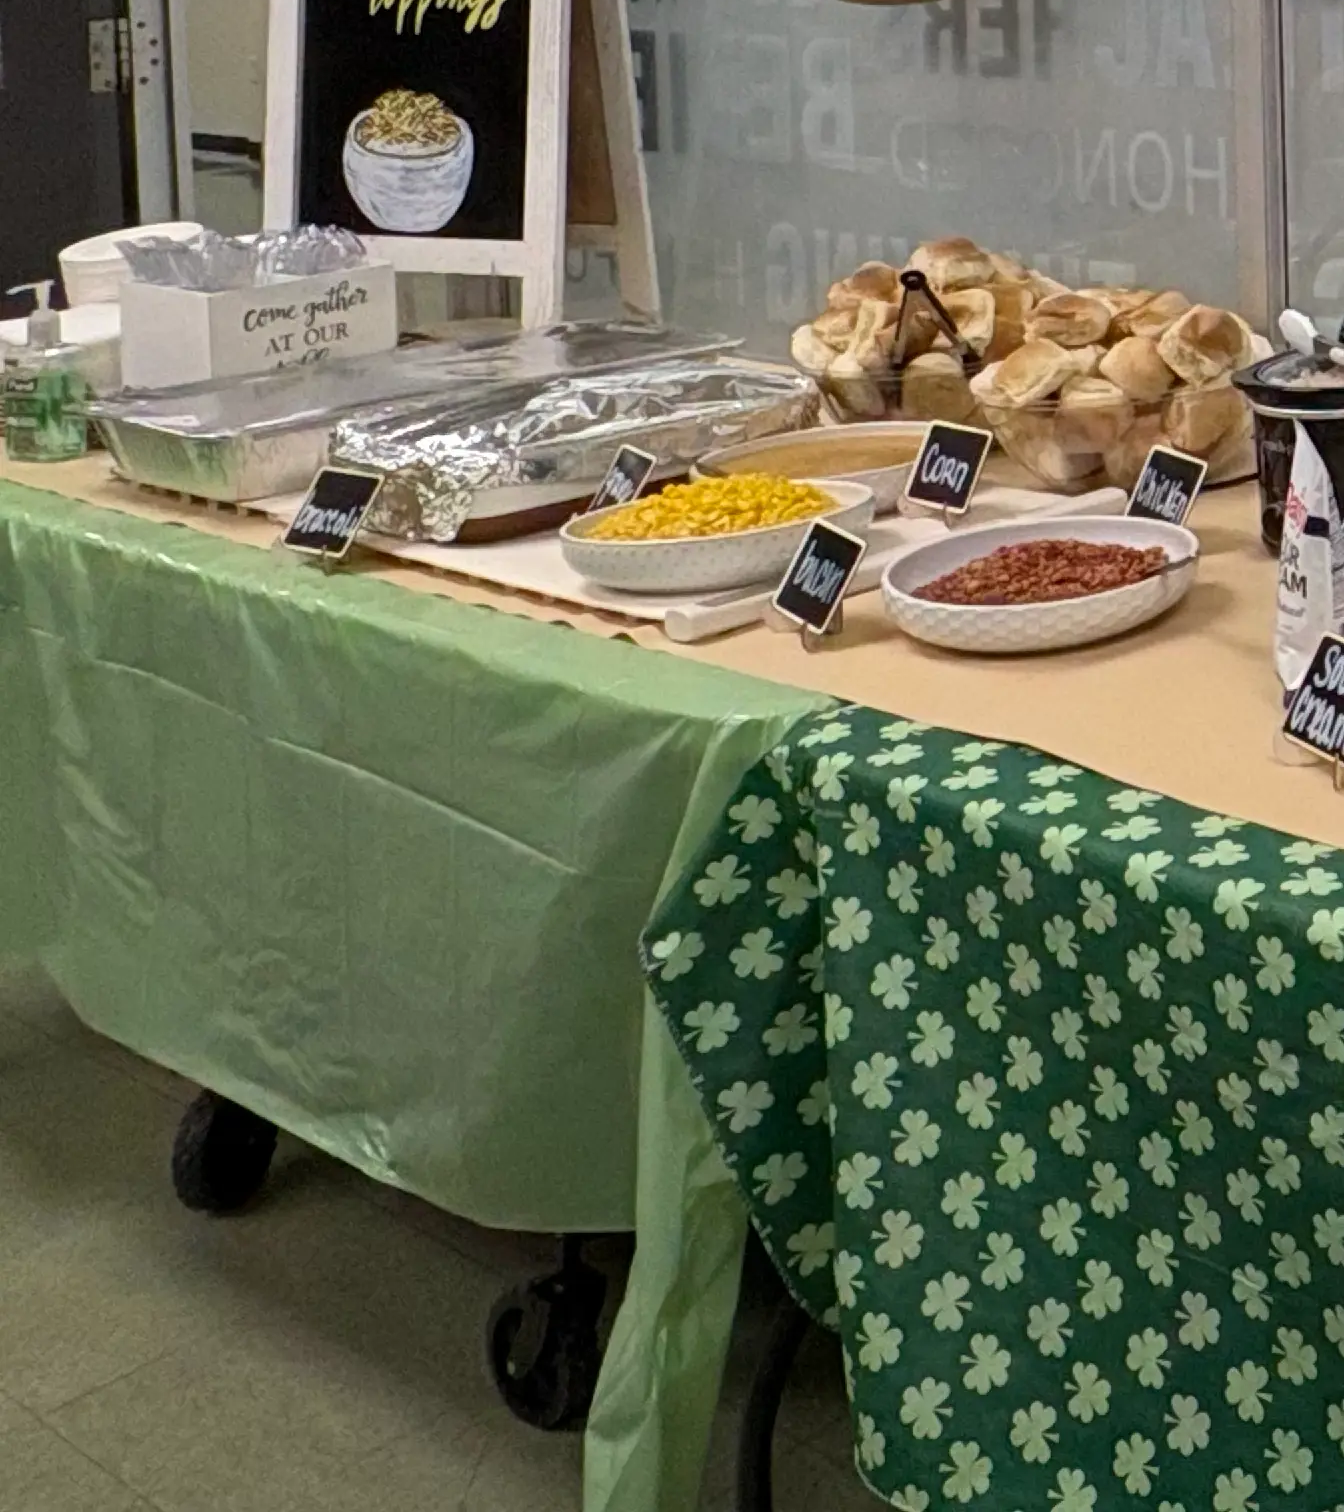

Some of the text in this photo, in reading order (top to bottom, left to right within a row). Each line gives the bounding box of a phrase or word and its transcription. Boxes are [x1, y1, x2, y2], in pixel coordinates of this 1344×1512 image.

[303, 280, 369, 328] gather
[264, 332, 296, 358] AT
[303, 322, 350, 347] OUR
